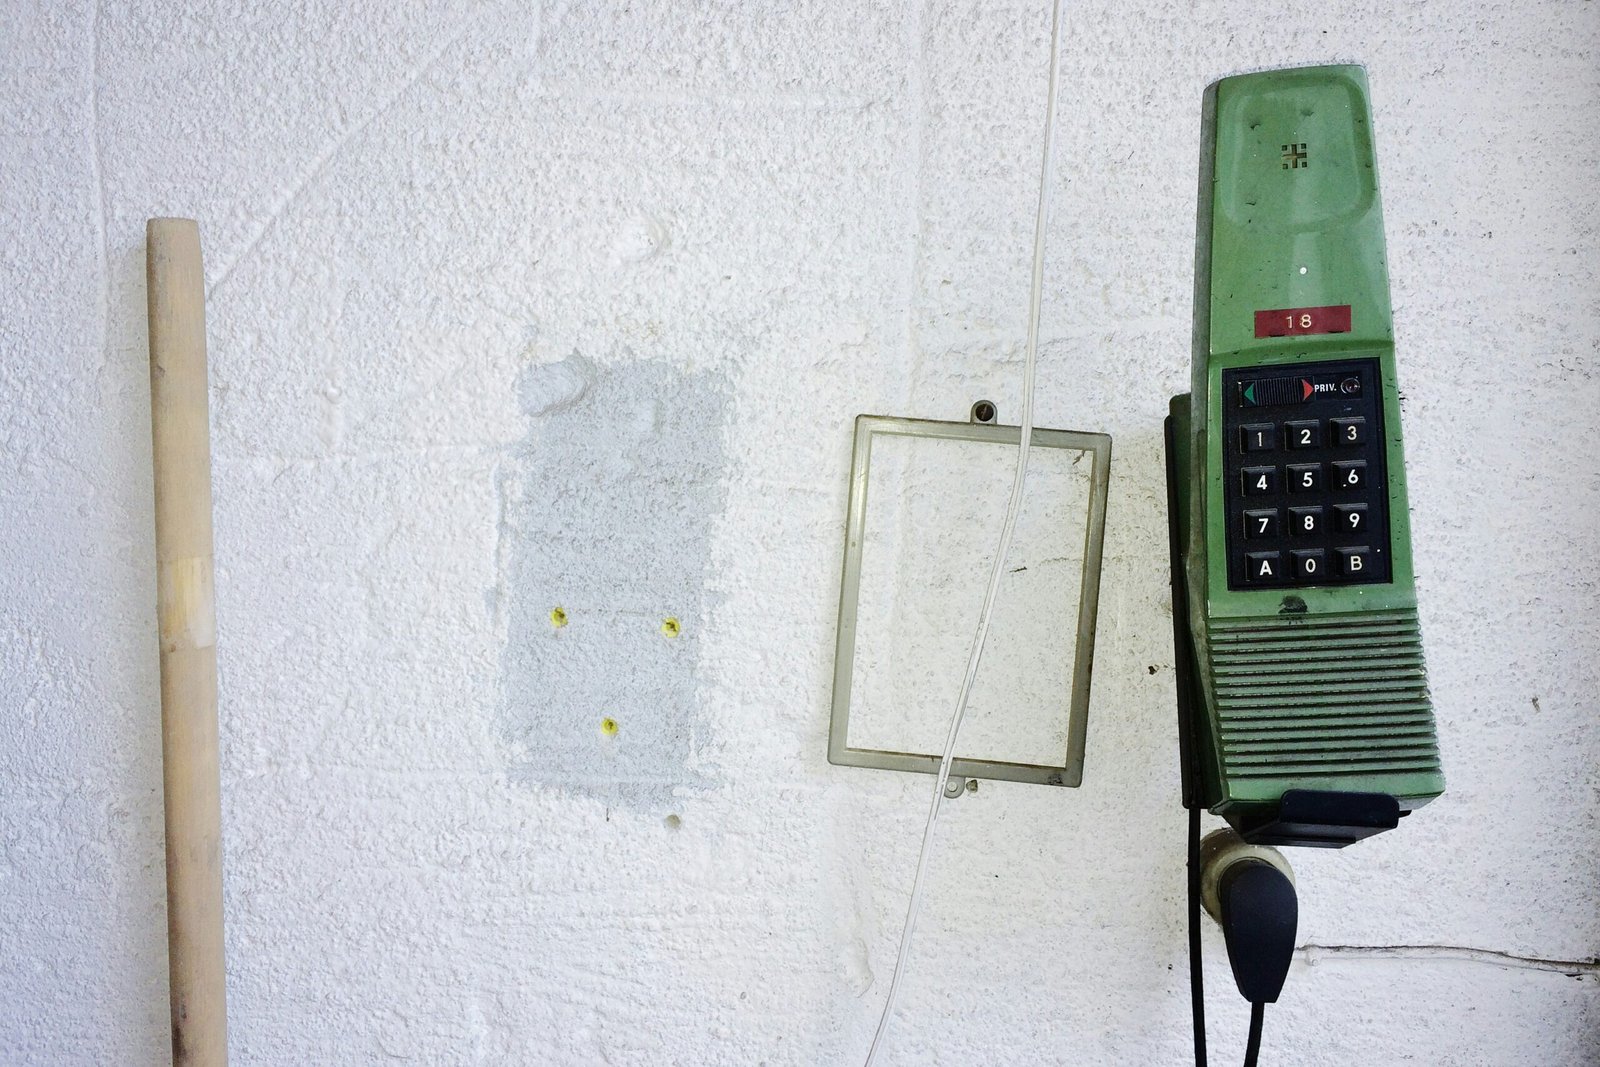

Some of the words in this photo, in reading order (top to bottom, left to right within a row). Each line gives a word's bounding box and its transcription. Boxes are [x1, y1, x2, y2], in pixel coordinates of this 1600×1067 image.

[1286, 314, 1312, 329] 18
[1314, 383, 1337, 393] PRIV.
[1257, 431, 1262, 447] 1
[1300, 429, 1311, 444] 2
[1347, 425, 1357, 441] 3
[1256, 474, 1268, 490] 4
[1302, 471, 1313, 487] 5
[1348, 469, 1359, 484] 6
[1258, 517, 1269, 533] 7
[1304, 515, 1314, 530] 8
[1349, 512, 1360, 528] 9
[1259, 560, 1273, 576] A
[1350, 555, 1363, 571] B
